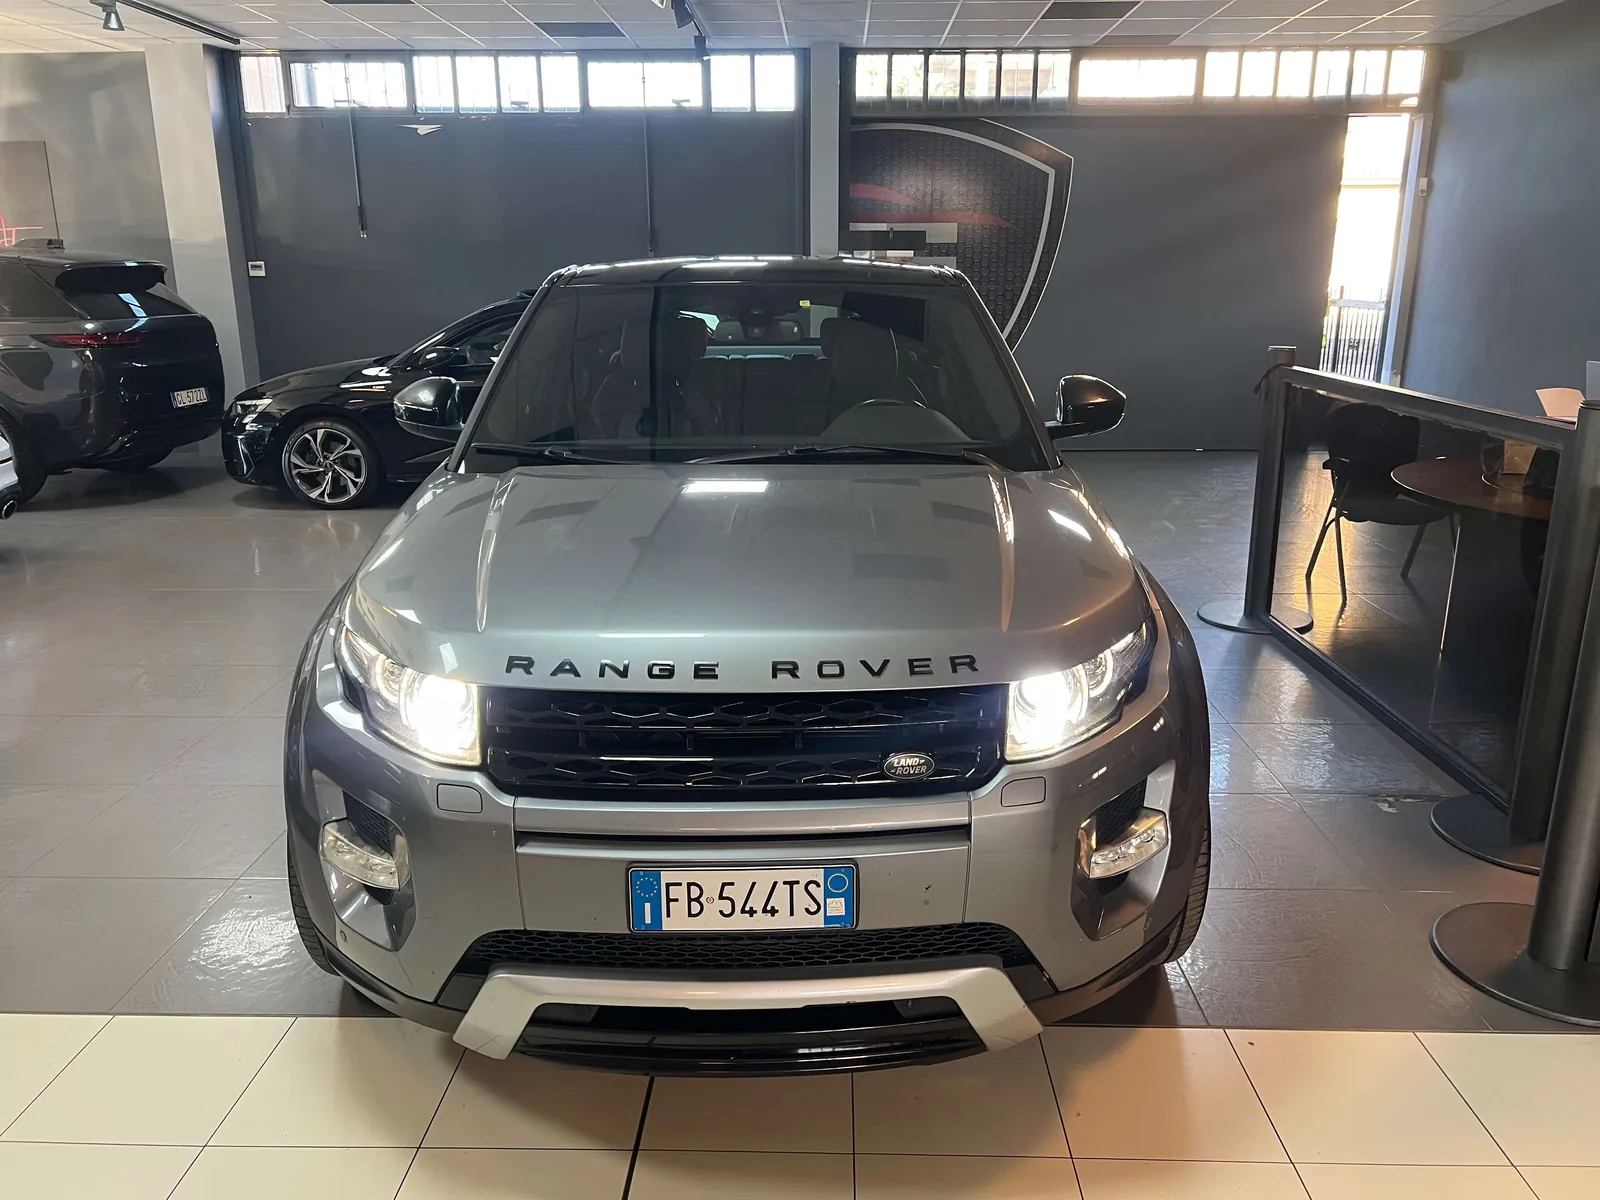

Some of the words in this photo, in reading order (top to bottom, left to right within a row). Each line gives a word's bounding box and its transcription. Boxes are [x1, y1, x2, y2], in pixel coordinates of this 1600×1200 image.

[505, 655, 721, 681] RANGE
[771, 654, 979, 680] ROVER
[893, 757, 920, 767] LAND
[895, 765, 927, 775] ROVER
[664, 881, 705, 918] FB
[717, 879, 822, 918] 544TS
